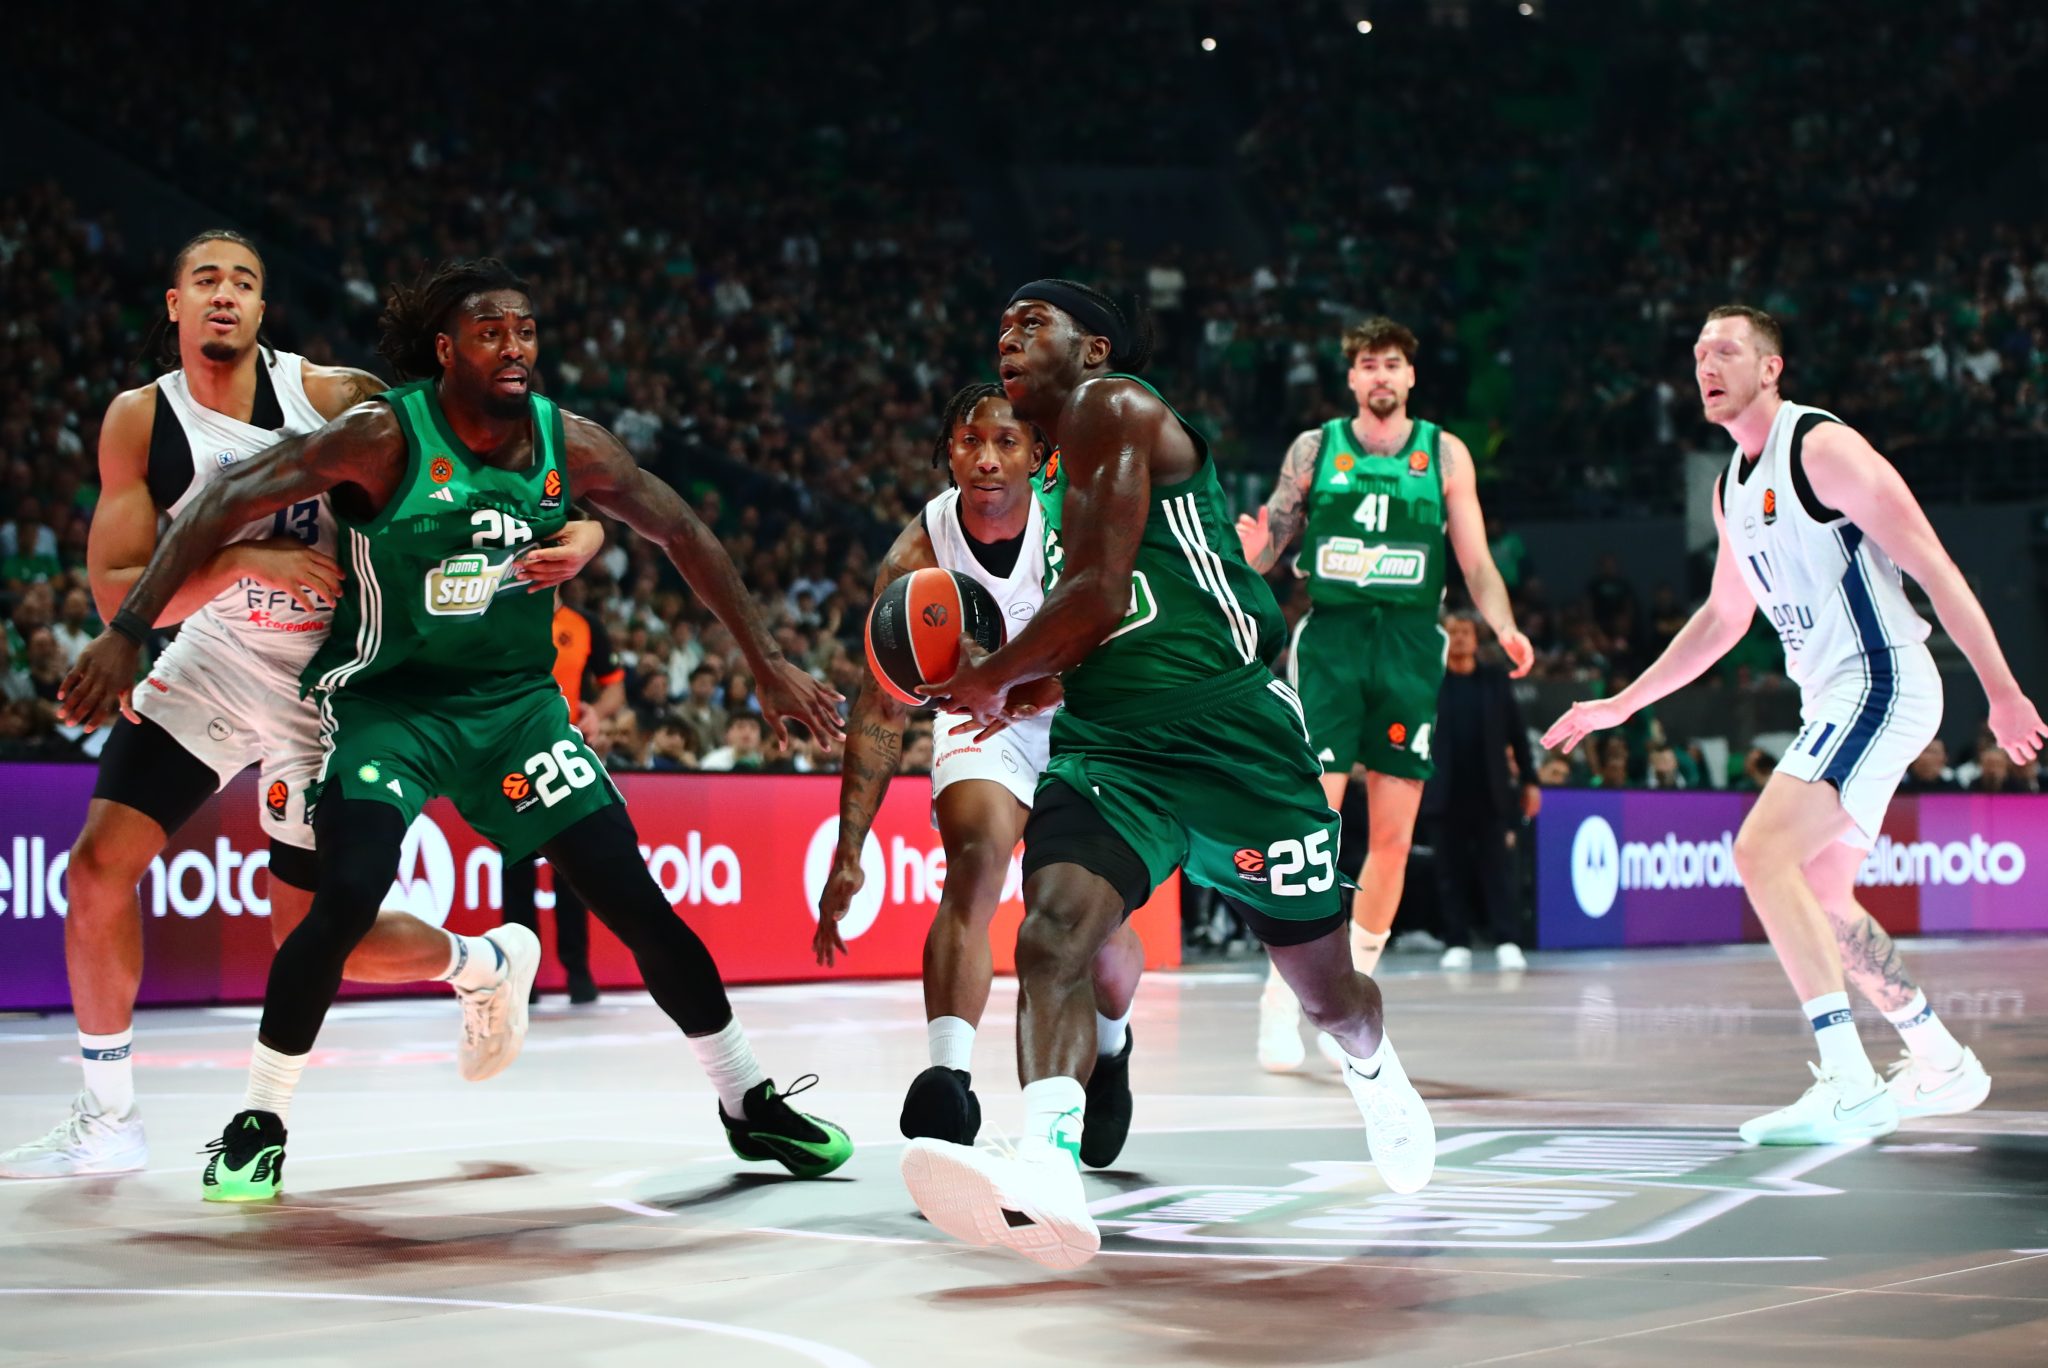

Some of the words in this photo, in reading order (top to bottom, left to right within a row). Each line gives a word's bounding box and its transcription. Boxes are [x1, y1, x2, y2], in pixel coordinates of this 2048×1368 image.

[272, 499, 319, 545] 13
[471, 509, 533, 549] 26
[1353, 493, 1390, 532] 41
[1410, 723, 1433, 761] 4
[524, 739, 596, 808] 26
[1267, 828, 1335, 896] 25
